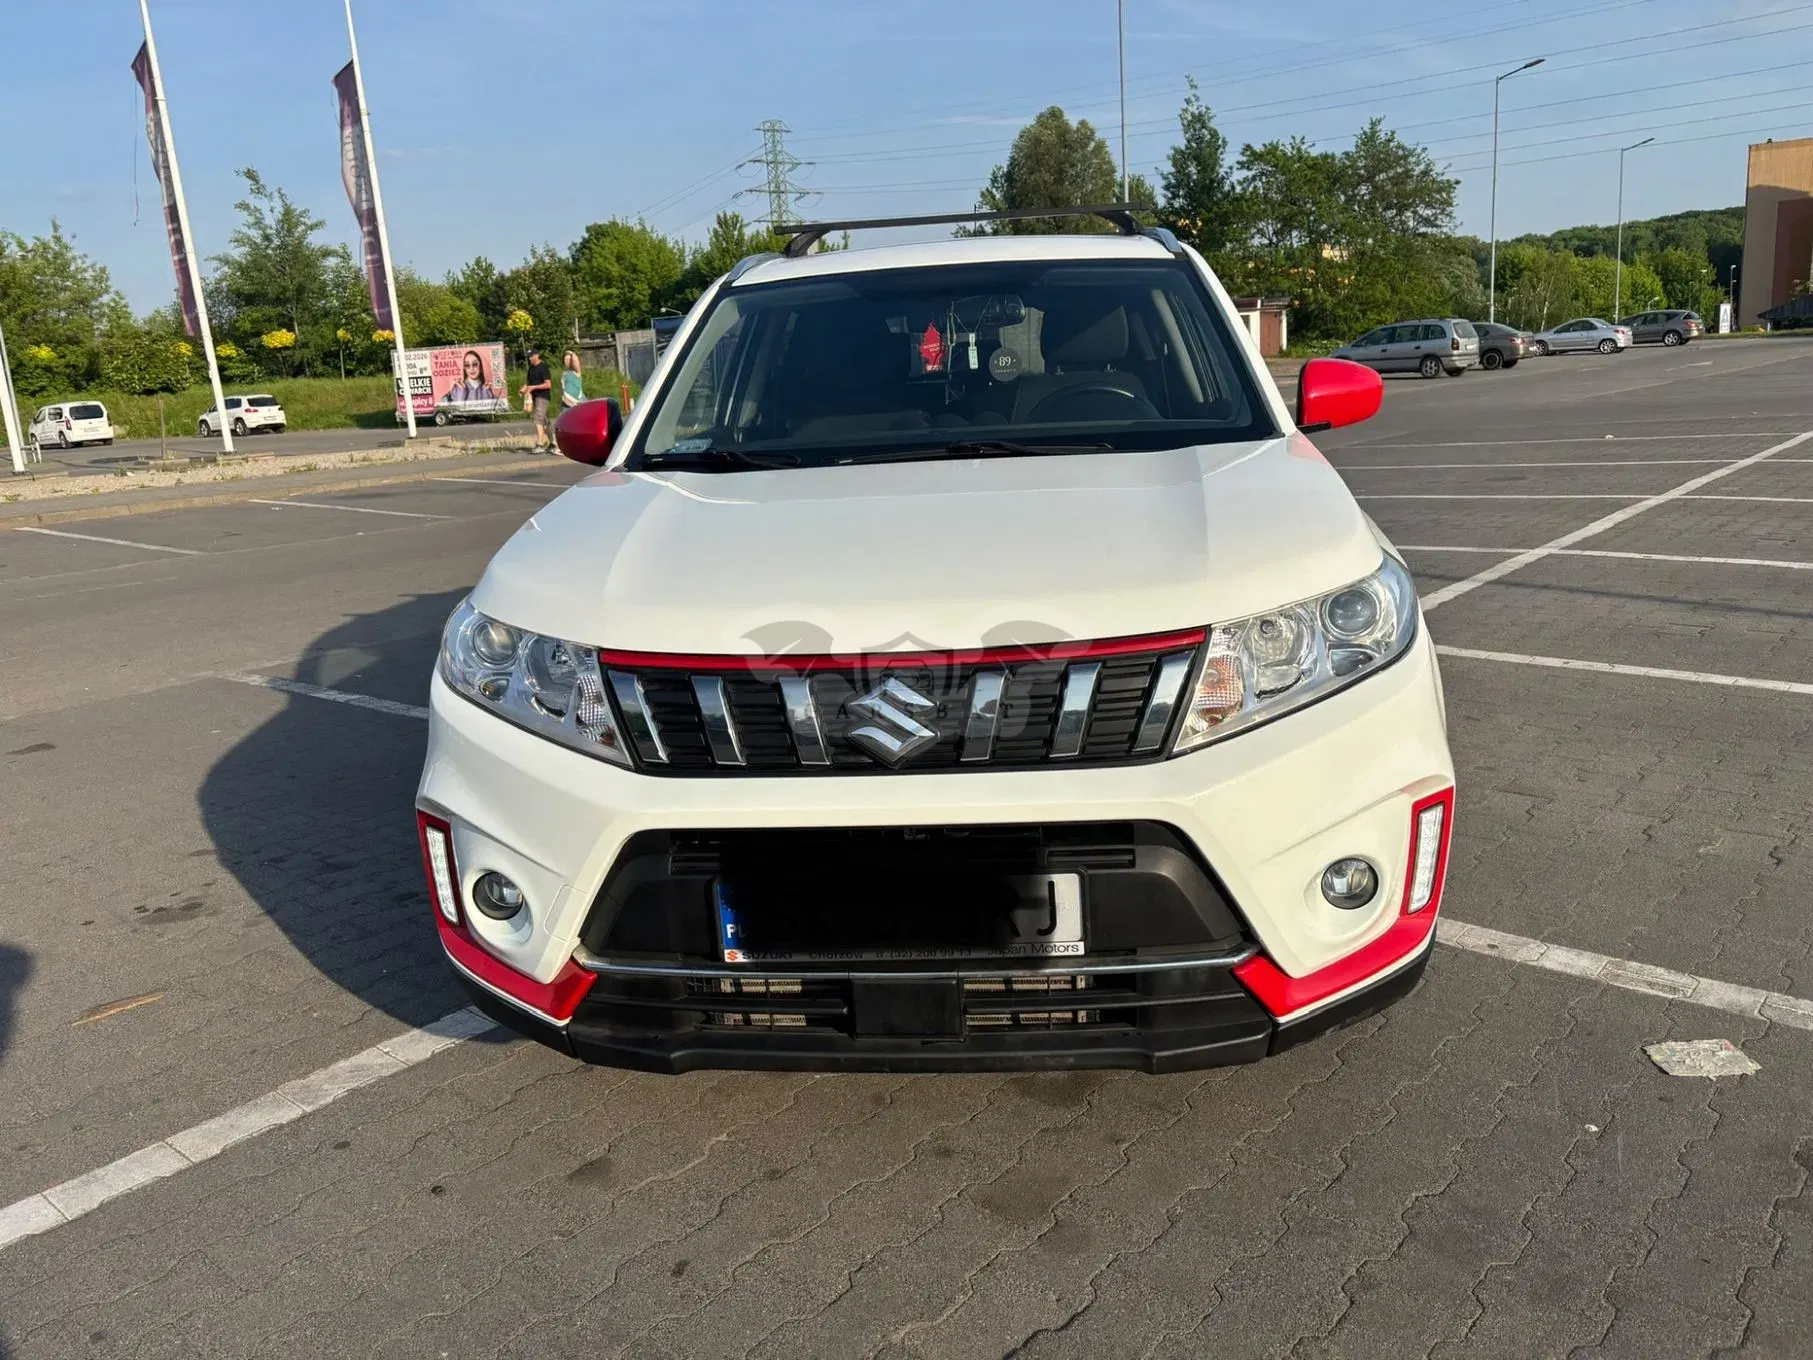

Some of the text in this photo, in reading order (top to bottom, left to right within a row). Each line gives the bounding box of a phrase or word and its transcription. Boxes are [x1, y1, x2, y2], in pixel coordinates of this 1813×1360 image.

[434, 360, 458, 369] TANIA
[999, 356, 1011, 367] 89
[398, 378, 432, 389] WELKIE
[399, 387, 432, 396] OWARCIE
[988, 945, 1026, 957] Japan
[1031, 943, 1080, 955] Motors
